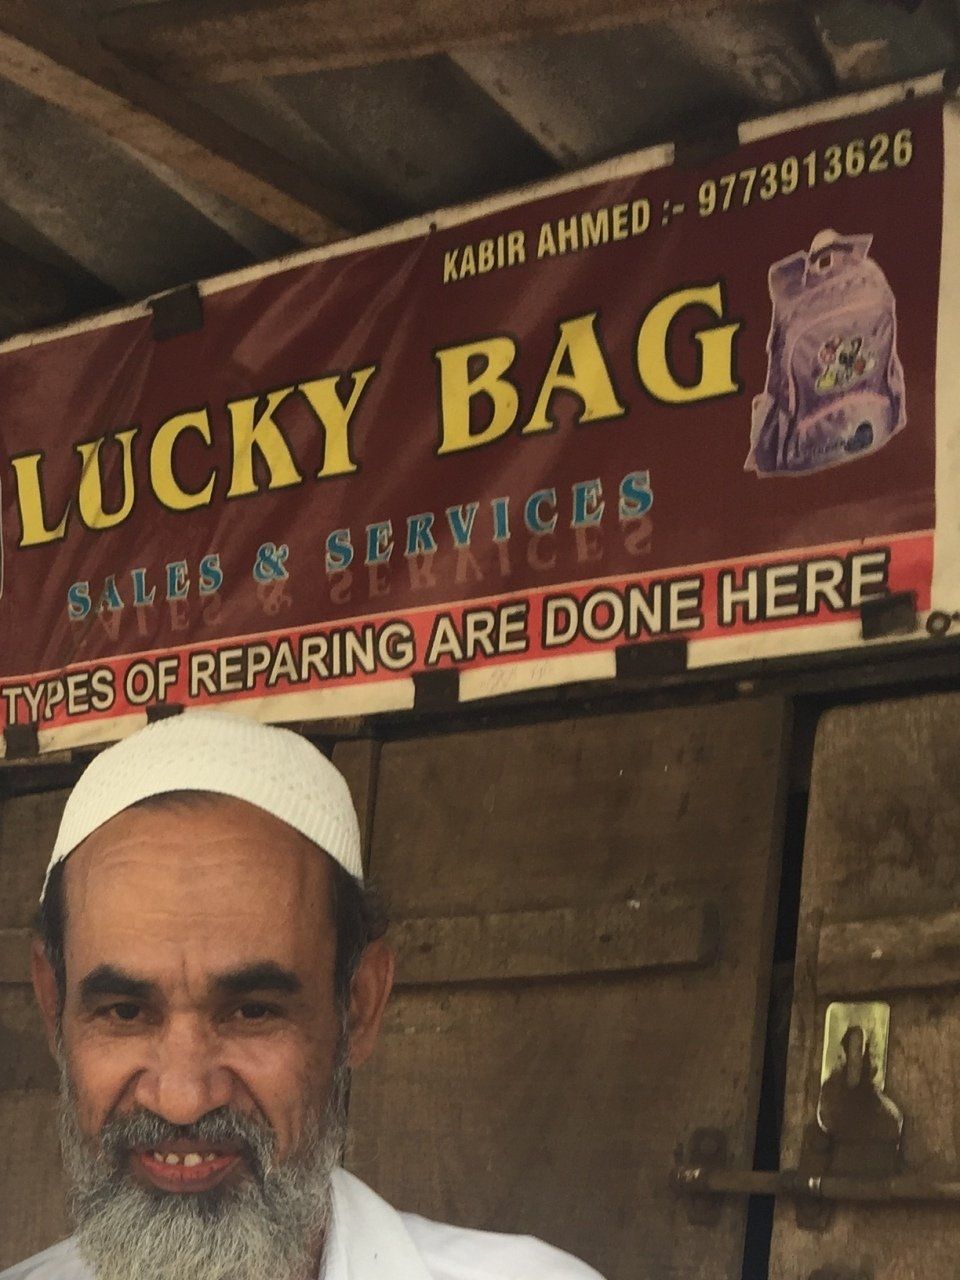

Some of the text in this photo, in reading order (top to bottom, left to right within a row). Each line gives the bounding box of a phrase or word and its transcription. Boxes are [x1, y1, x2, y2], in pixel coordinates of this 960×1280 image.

[443, 231, 526, 283] KABIR
[537, 199, 651, 257] AHMED
[697, 128, 914, 217] 9773913626
[11, 282, 740, 546] LUCKY BAG
[67, 470, 654, 621] SALES & SERVICES
[2, 668, 115, 726] TYPES
[125, 657, 178, 704] OF
[190, 621, 415, 698] REPARING
[427, 602, 528, 667] ARE
[544, 579, 702, 648] DONE
[722, 551, 889, 624] HERE
